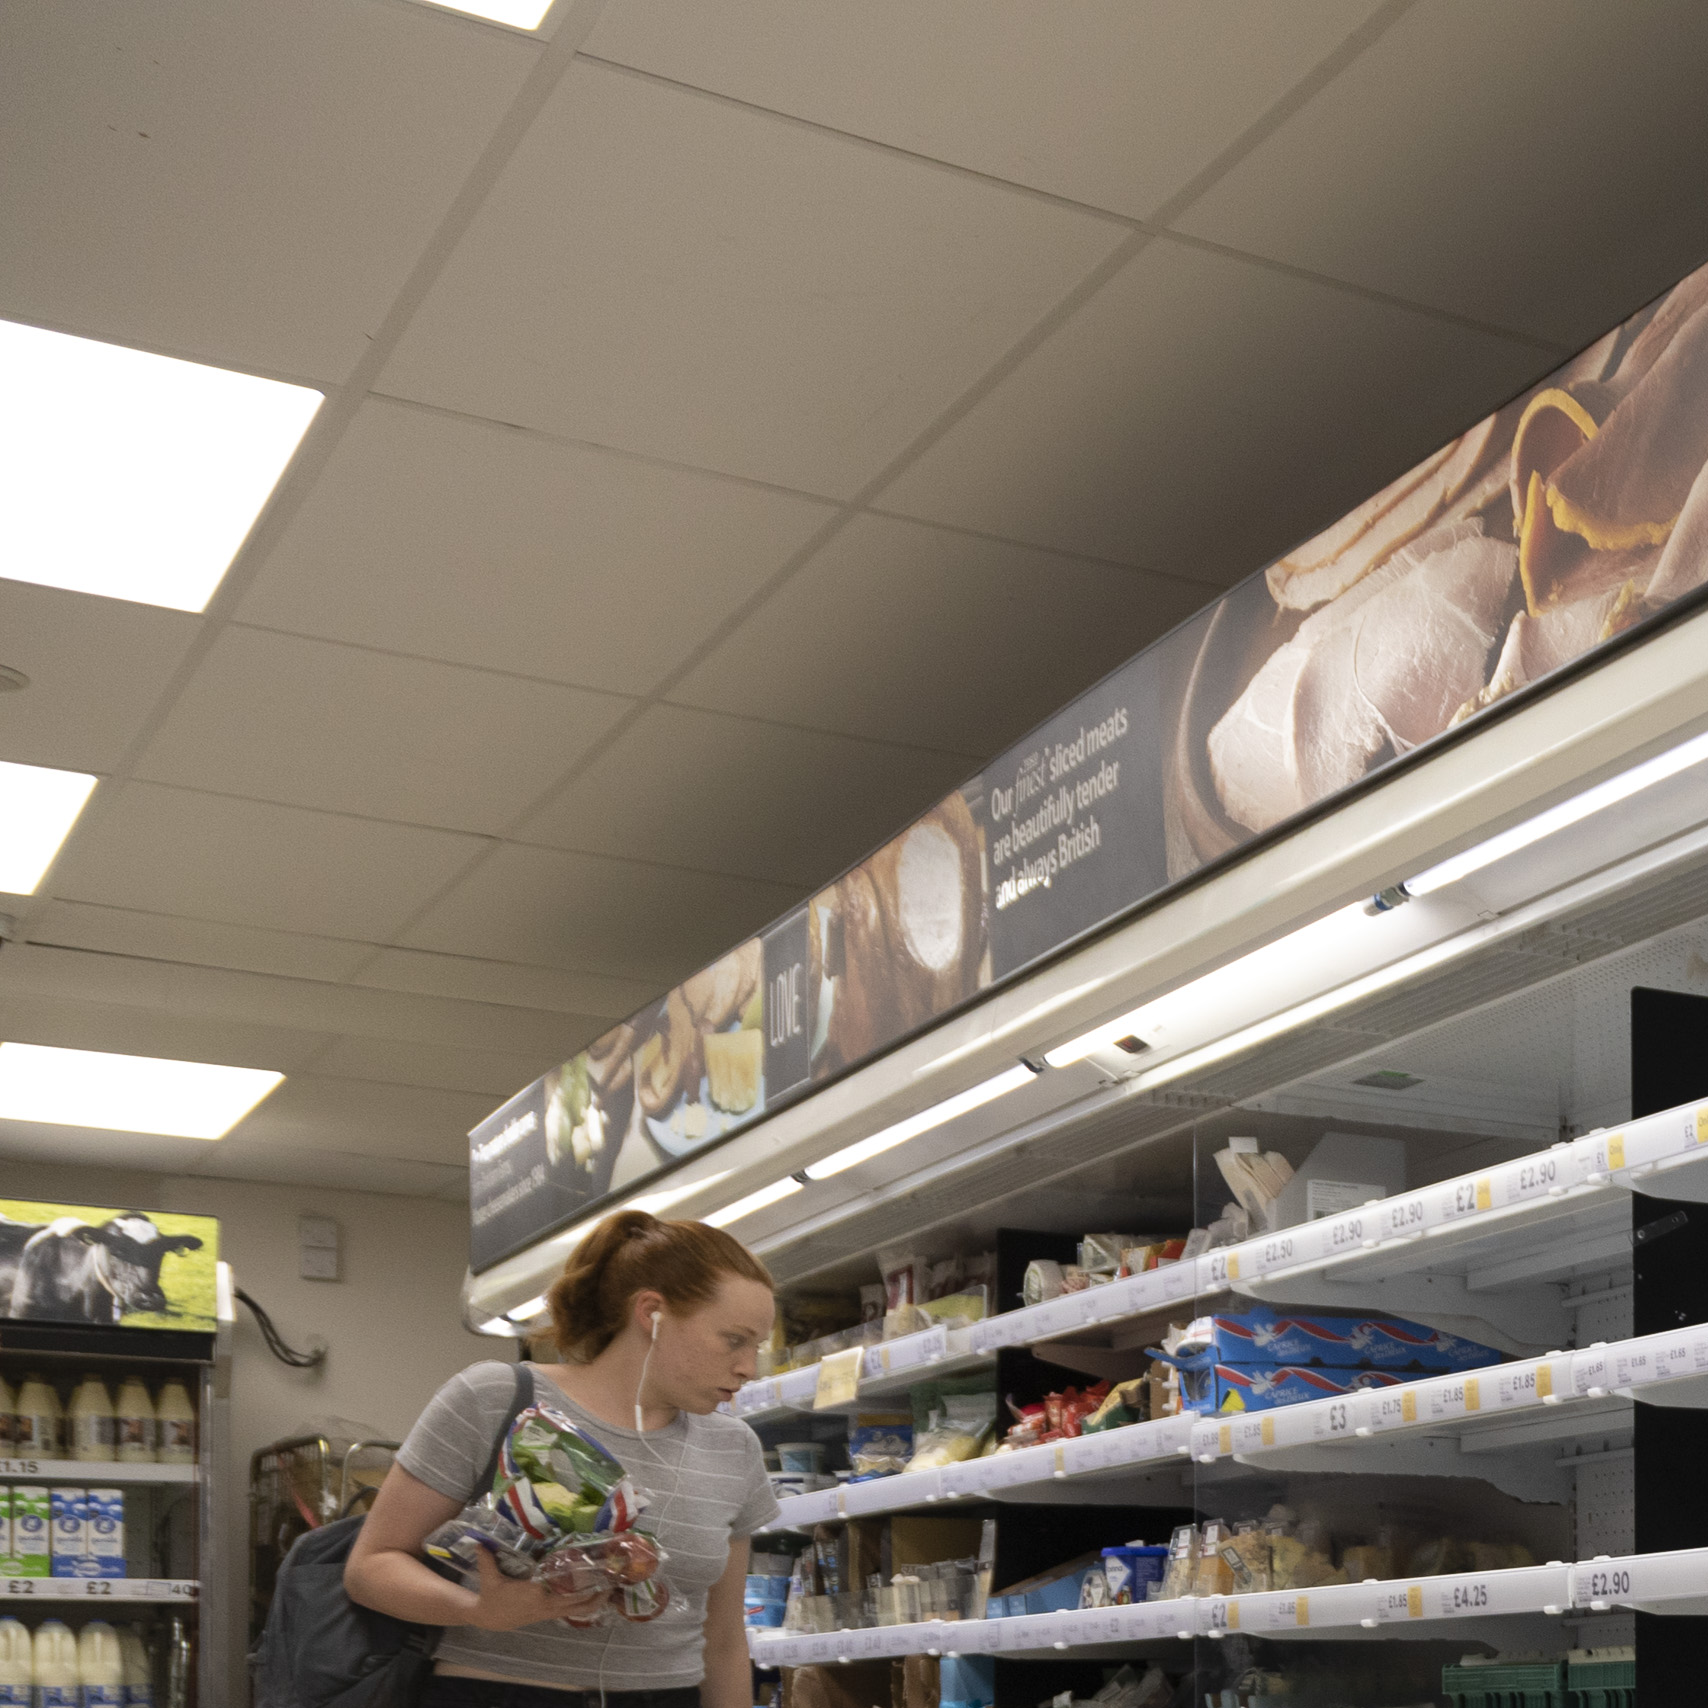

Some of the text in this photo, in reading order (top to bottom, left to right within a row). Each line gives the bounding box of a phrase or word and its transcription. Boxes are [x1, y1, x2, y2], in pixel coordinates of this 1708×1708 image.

[991, 786, 1014, 822] Our
[1049, 734, 1084, 783] sliced
[1087, 707, 1127, 751] meats
[993, 760, 1120, 866] are beautifully tender
[995, 815, 1100, 910] and always British
[769, 962, 801, 1047] LOVE
[1520, 1160, 1556, 1191] £2.90
[1456, 1187, 1475, 1213] £2
[1392, 1201, 1424, 1228] £2.90
[1333, 1219, 1363, 1246] £2.90
[1211, 1259, 1226, 1281] £2
[1631, 1355, 1647, 1368] £1.65
[1670, 1347, 1686, 1360] £1.65
[1329, 1403, 1346, 1432] £3
[9, 1579, 34, 1595] £2
[86, 1580, 112, 1596] £2
[1453, 1585, 1488, 1608] £4.25
[1591, 1570, 1631, 1597] £2.90
